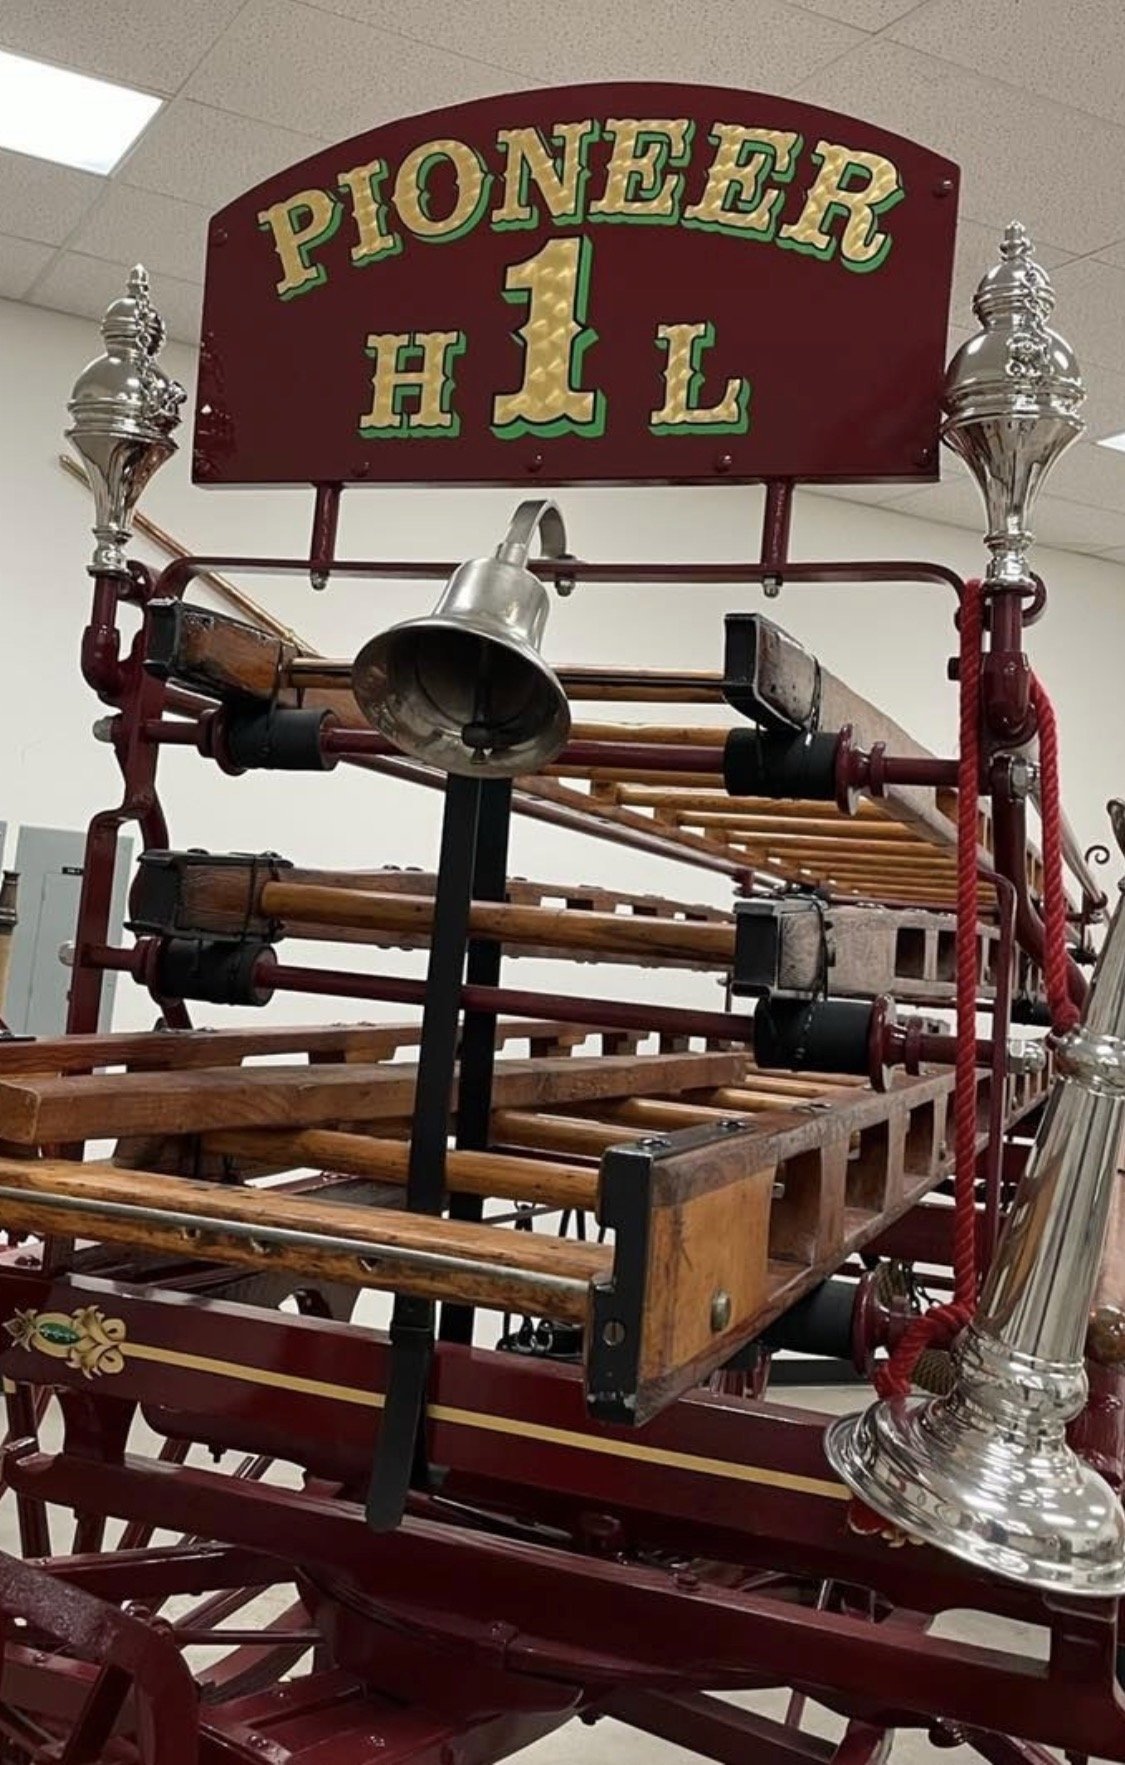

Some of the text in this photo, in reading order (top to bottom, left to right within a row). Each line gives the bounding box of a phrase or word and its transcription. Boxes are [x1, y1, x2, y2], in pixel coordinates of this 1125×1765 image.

[258, 117, 904, 300] PIONEER
[360, 236, 750, 439] H 1 L
